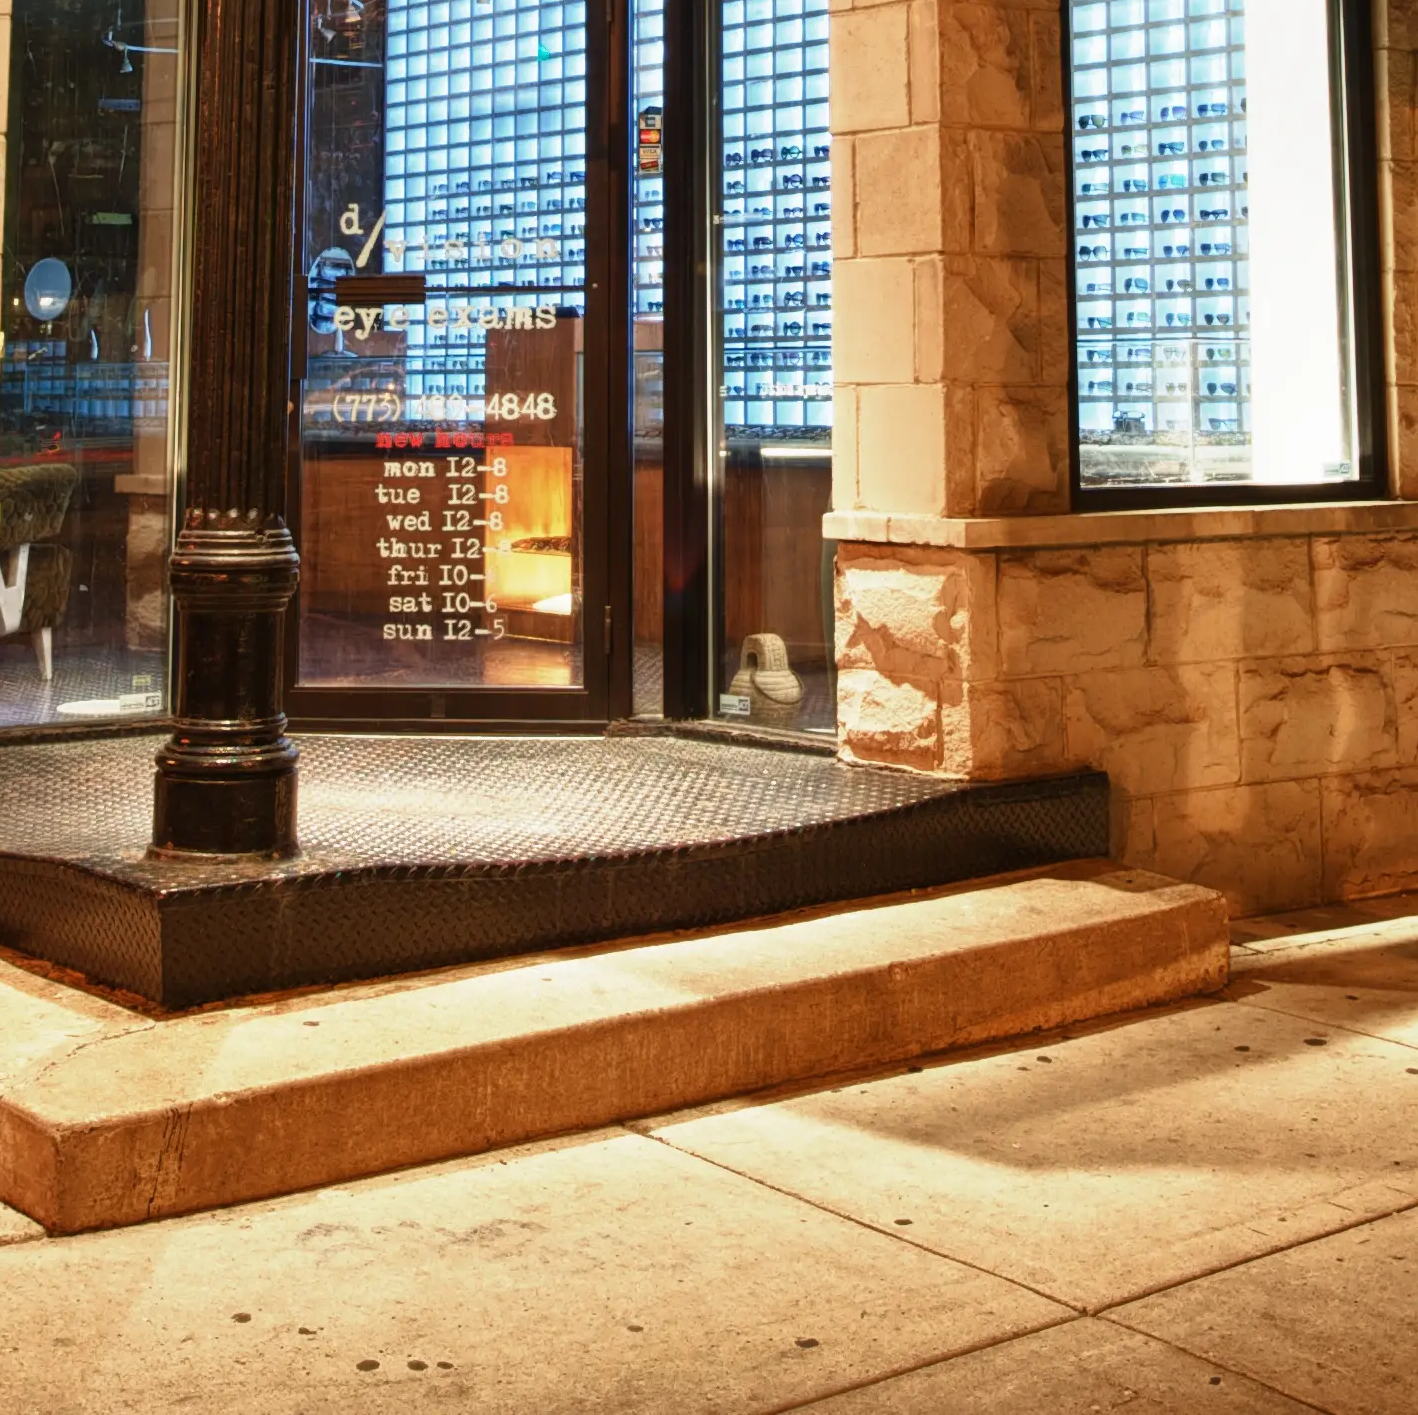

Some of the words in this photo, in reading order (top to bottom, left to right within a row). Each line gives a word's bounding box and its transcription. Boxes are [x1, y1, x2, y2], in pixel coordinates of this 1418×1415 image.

[339, 202, 561, 268] d/vision
[333, 304, 410, 341] eye
[427, 305, 558, 330] exams
[332, 391, 402, 423] (773)
[413, 391, 558, 422] 489-4848
[374, 430, 425, 449] new
[433, 426, 515, 450] hours
[383, 459, 436, 478] mon
[445, 456, 508, 478] 12-8
[374, 483, 421, 505] tue
[447, 483, 510, 505] 12-8
[386, 510, 433, 532] wed
[441, 510, 504, 532] 12-8
[375, 536, 443, 559] thur
[386, 564, 430, 586] fri
[438, 564, 496, 586] 10-
[388, 591, 433, 614] sat
[441, 591, 499, 614] 10-6
[382, 623, 434, 641] sun
[442, 618, 506, 641] 12-5
